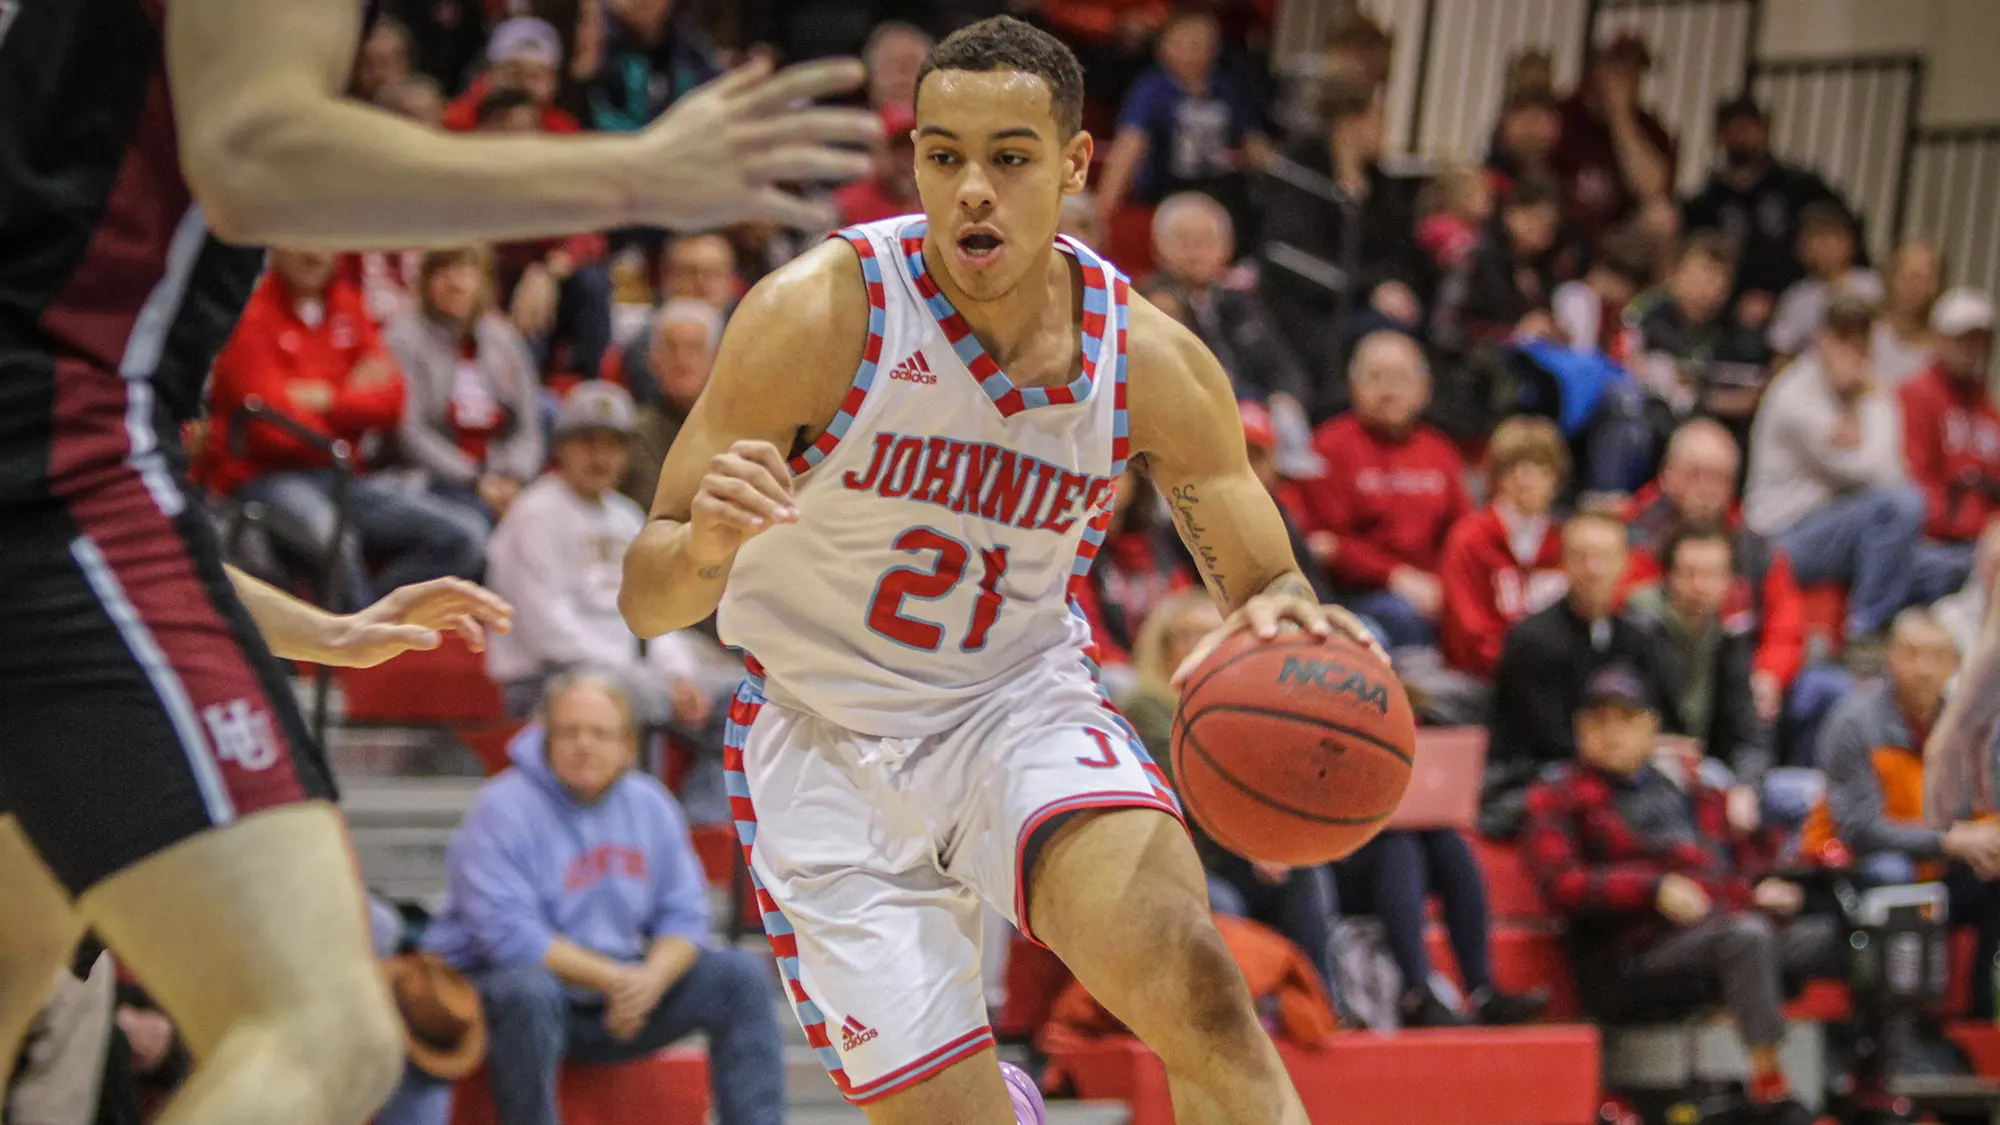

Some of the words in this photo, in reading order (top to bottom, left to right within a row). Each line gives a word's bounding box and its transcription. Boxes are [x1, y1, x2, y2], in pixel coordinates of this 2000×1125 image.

[889, 368, 937, 384] adidas
[864, 524, 1010, 653] 21
[1277, 654, 1388, 716] NCAA
[203, 700, 277, 771] HU
[1075, 726, 1121, 769] J
[842, 1028, 878, 1052] adidas
